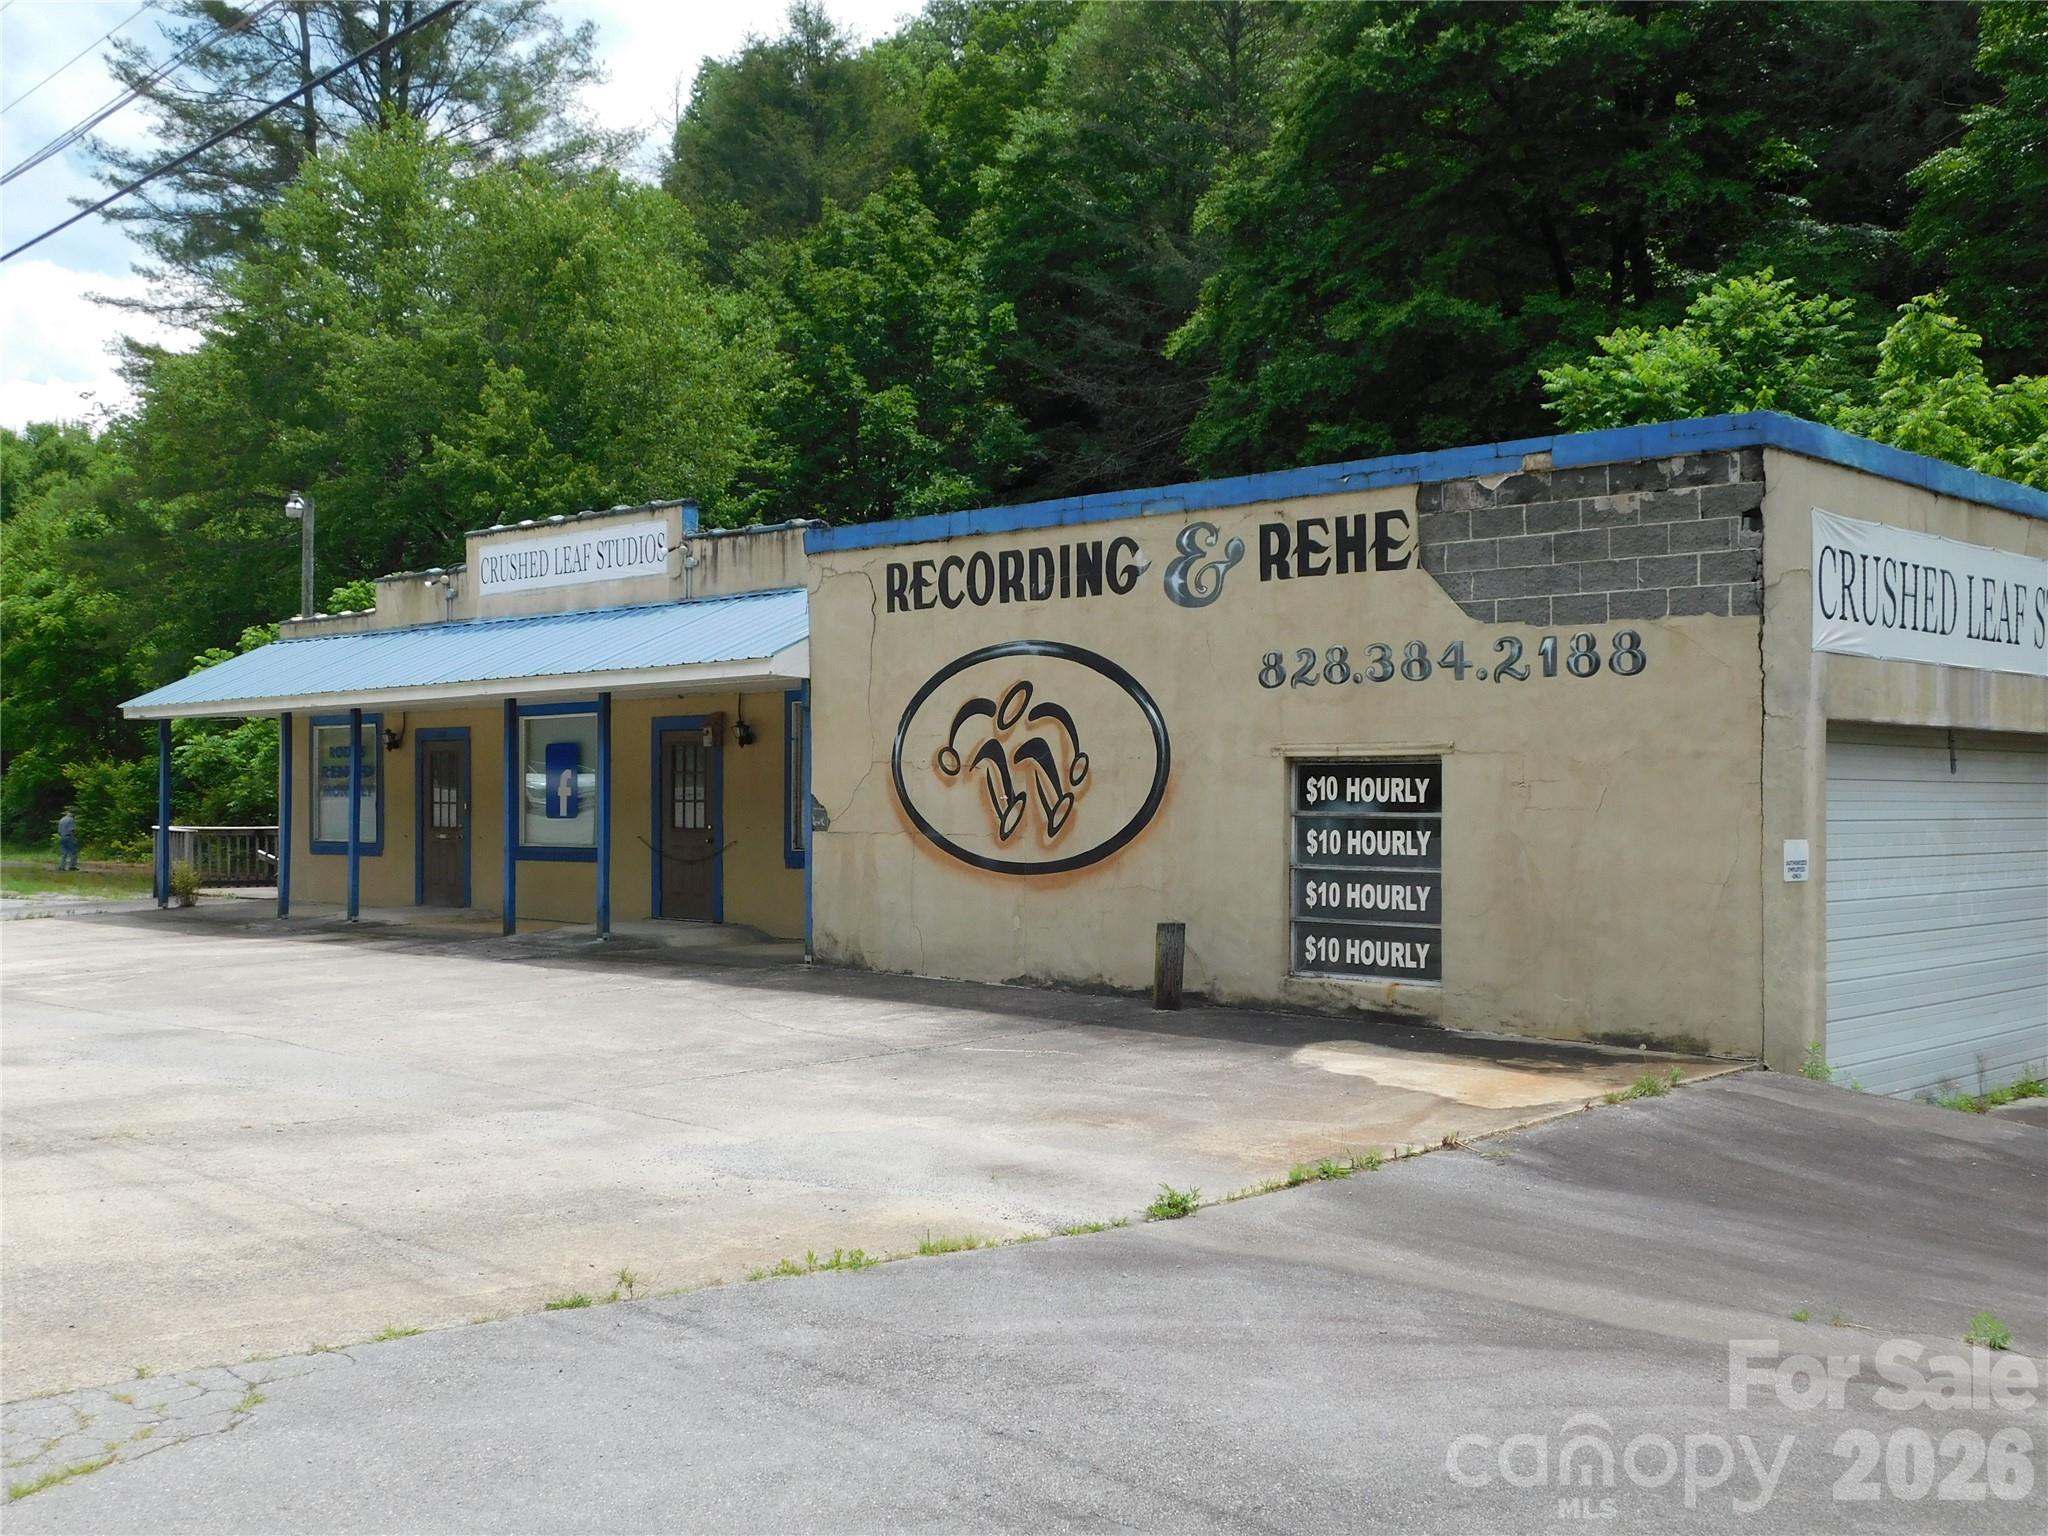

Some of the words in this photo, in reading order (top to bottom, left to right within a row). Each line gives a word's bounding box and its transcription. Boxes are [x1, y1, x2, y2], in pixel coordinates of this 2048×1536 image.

[480, 549, 549, 585] CRUSHED
[554, 542, 592, 575] LEAF
[596, 532, 665, 570] STUDIOS
[886, 536, 1152, 614] RECORDING
[1163, 520, 1245, 608] &
[1259, 508, 1422, 582] REHE
[1818, 545, 1957, 635] CRUSHED
[1966, 574, 2027, 645] LEAF
[2034, 586, 2048, 650] S
[1257, 629, 1648, 690] 828.384.2188
[557, 768, 572, 817] f
[1306, 776, 1338, 805] $10
[1346, 777, 1430, 803] HOURLY
[1306, 828, 1341, 857] $10
[1347, 830, 1431, 856] HOURLY
[1305, 880, 1340, 909] $10
[1346, 883, 1431, 911] HOURLY
[1305, 934, 1340, 964] $10
[1346, 939, 1430, 968] HOURLY
